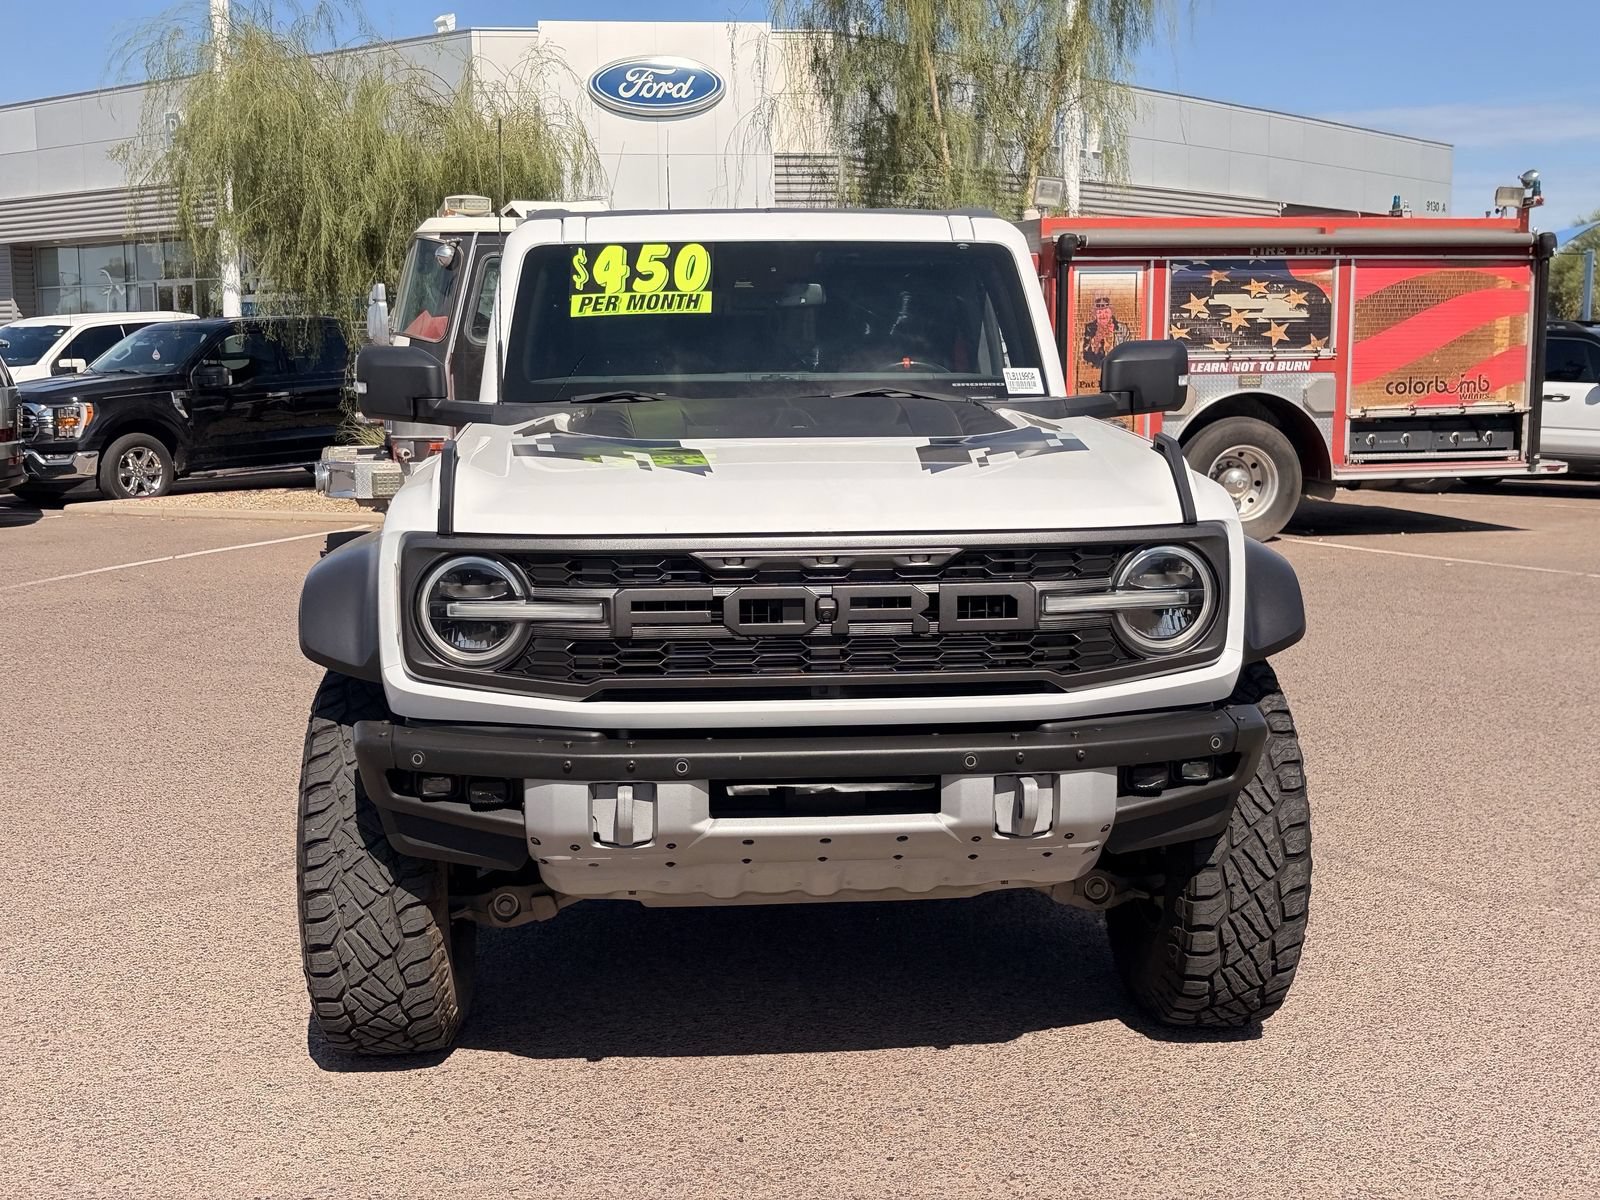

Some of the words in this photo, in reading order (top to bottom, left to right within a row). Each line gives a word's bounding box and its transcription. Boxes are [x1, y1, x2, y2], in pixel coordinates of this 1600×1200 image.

[619, 67, 695, 98] Ford
[572, 243, 711, 293] $450
[578, 295, 620, 313] PER
[626, 293, 703, 311] MONTH
[1190, 362, 1229, 372] LEARN
[1231, 361, 1256, 372] NOT
[1260, 361, 1275, 371] TO
[1277, 361, 1311, 371] BURN
[613, 582, 1037, 637] FORD
